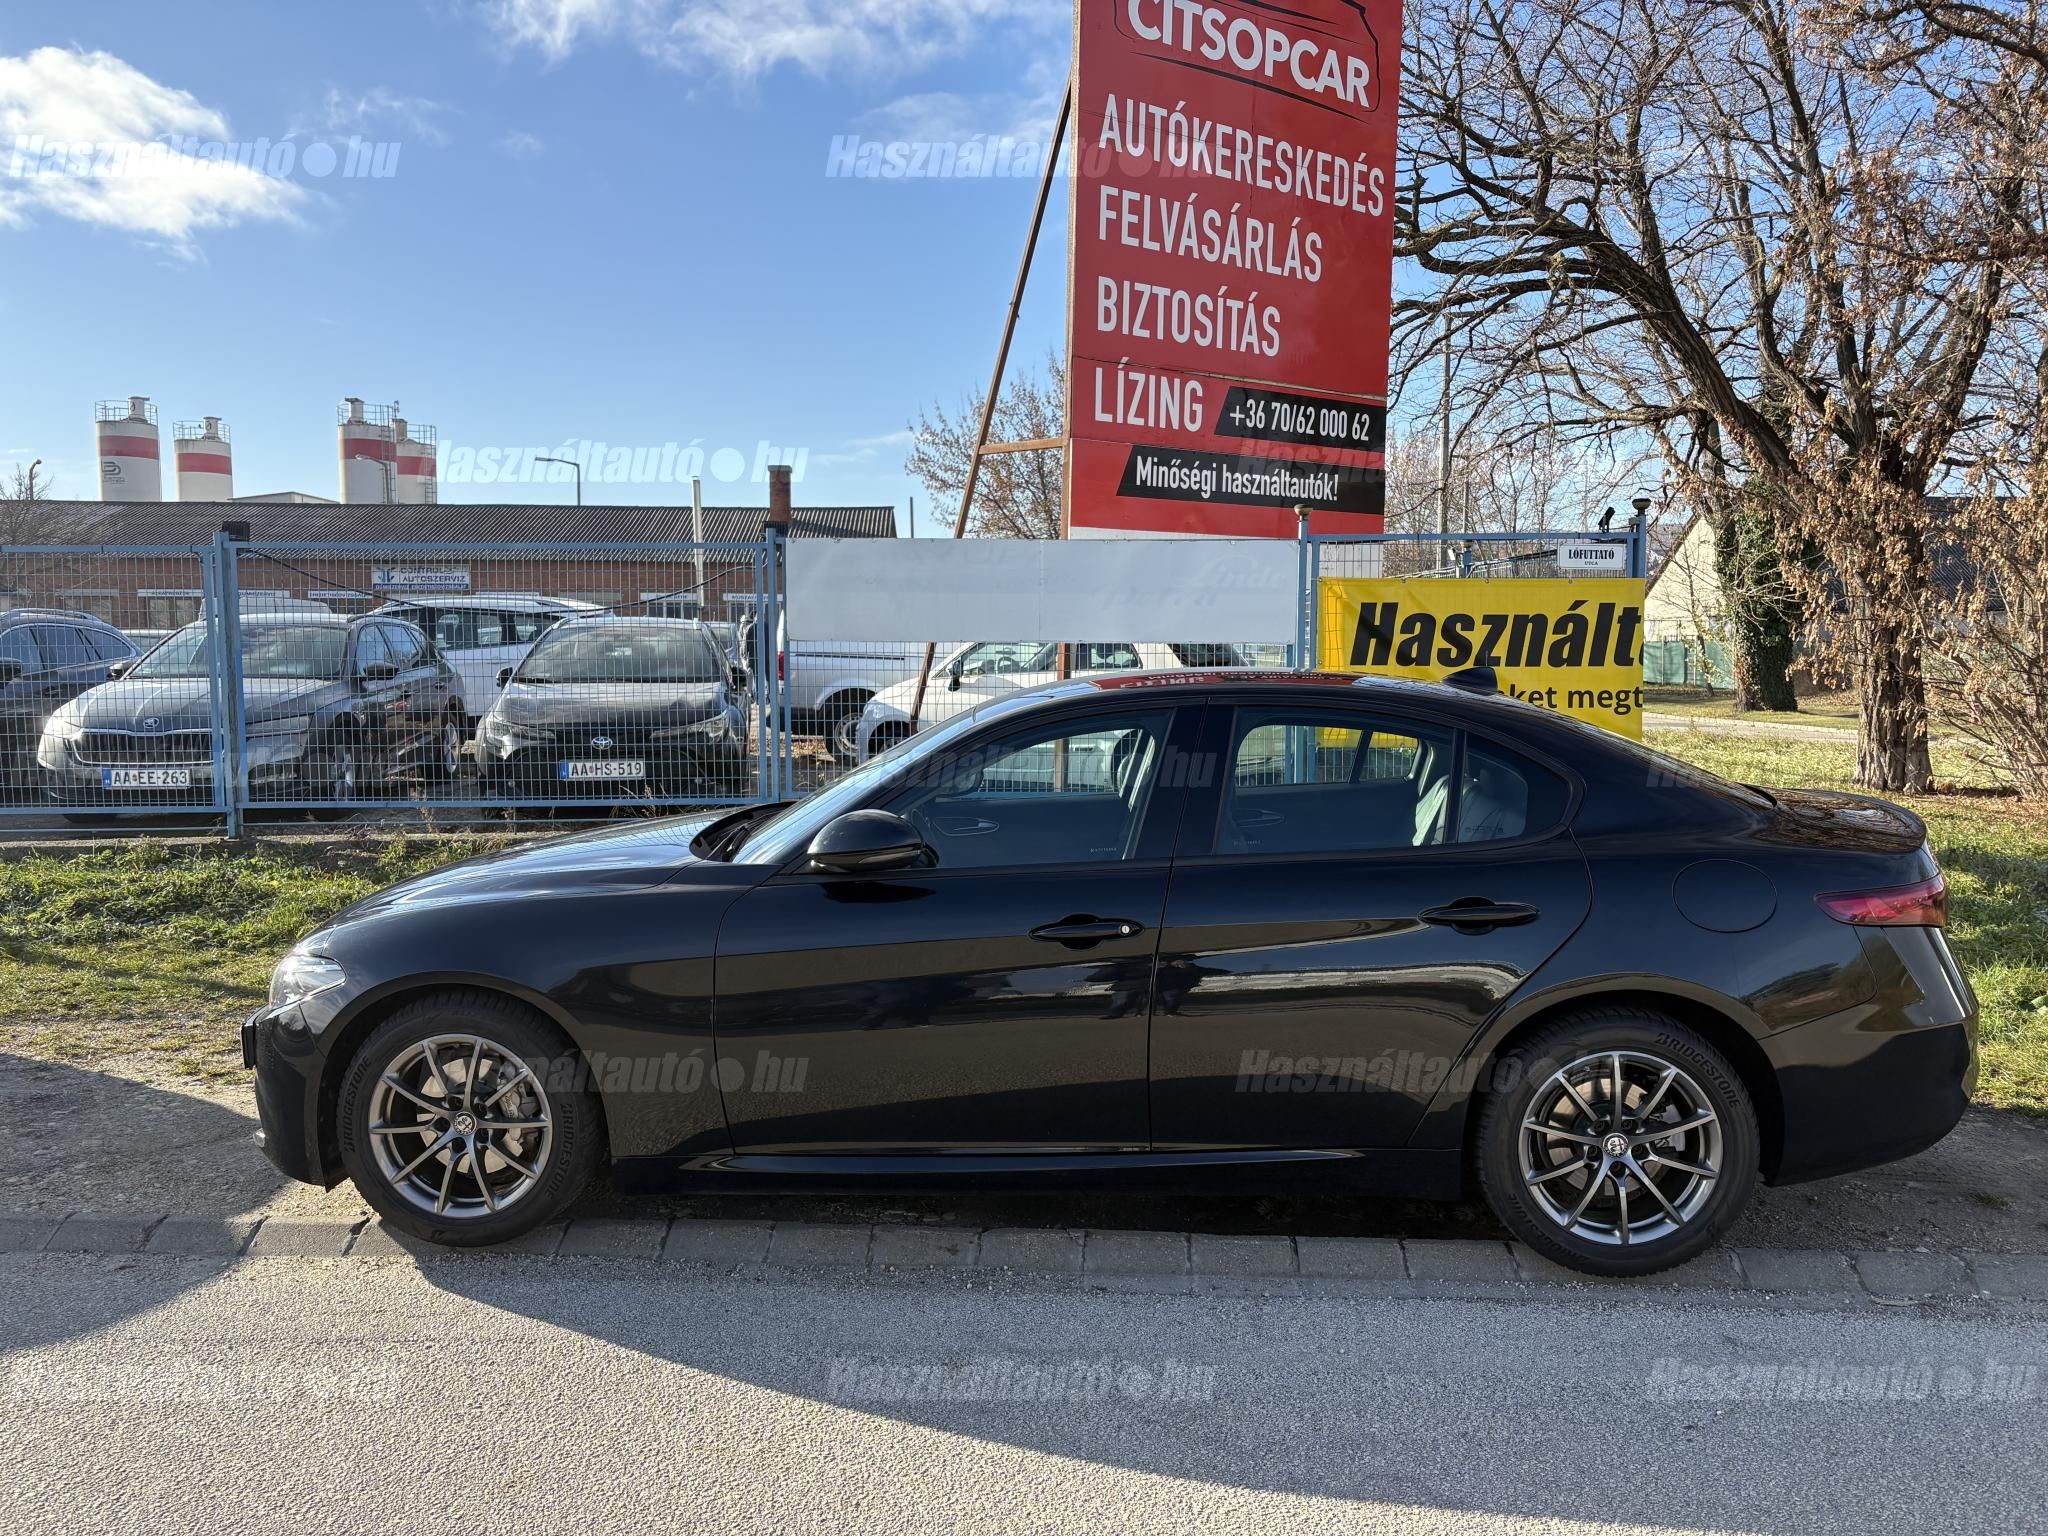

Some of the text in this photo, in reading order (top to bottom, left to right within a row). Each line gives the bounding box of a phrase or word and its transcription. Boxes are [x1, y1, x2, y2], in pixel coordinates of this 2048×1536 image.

[1127, 0, 1370, 108] CITSOPCAR
[1099, 93, 1385, 217] AUTÓKERESKEDÉS
[1099, 184, 1322, 282] FELVÁSÁRLÁS
[1097, 276, 1281, 357] BIZTOSÍTÁS
[1095, 357, 1204, 432] LÍZING
[1230, 400, 1370, 441] +36 70/62 000 62
[1136, 456, 1217, 498] Minőségi
[1222, 464, 1338, 501] használtautók!
[1568, 547, 1615, 559] LÓFUTTATÓ
[343, 1056, 372, 1153] BRIDGESTONE
[1655, 1032, 1740, 1108] BRIDGESTONE
[545, 1103, 575, 1199] BRIDGESTONE
